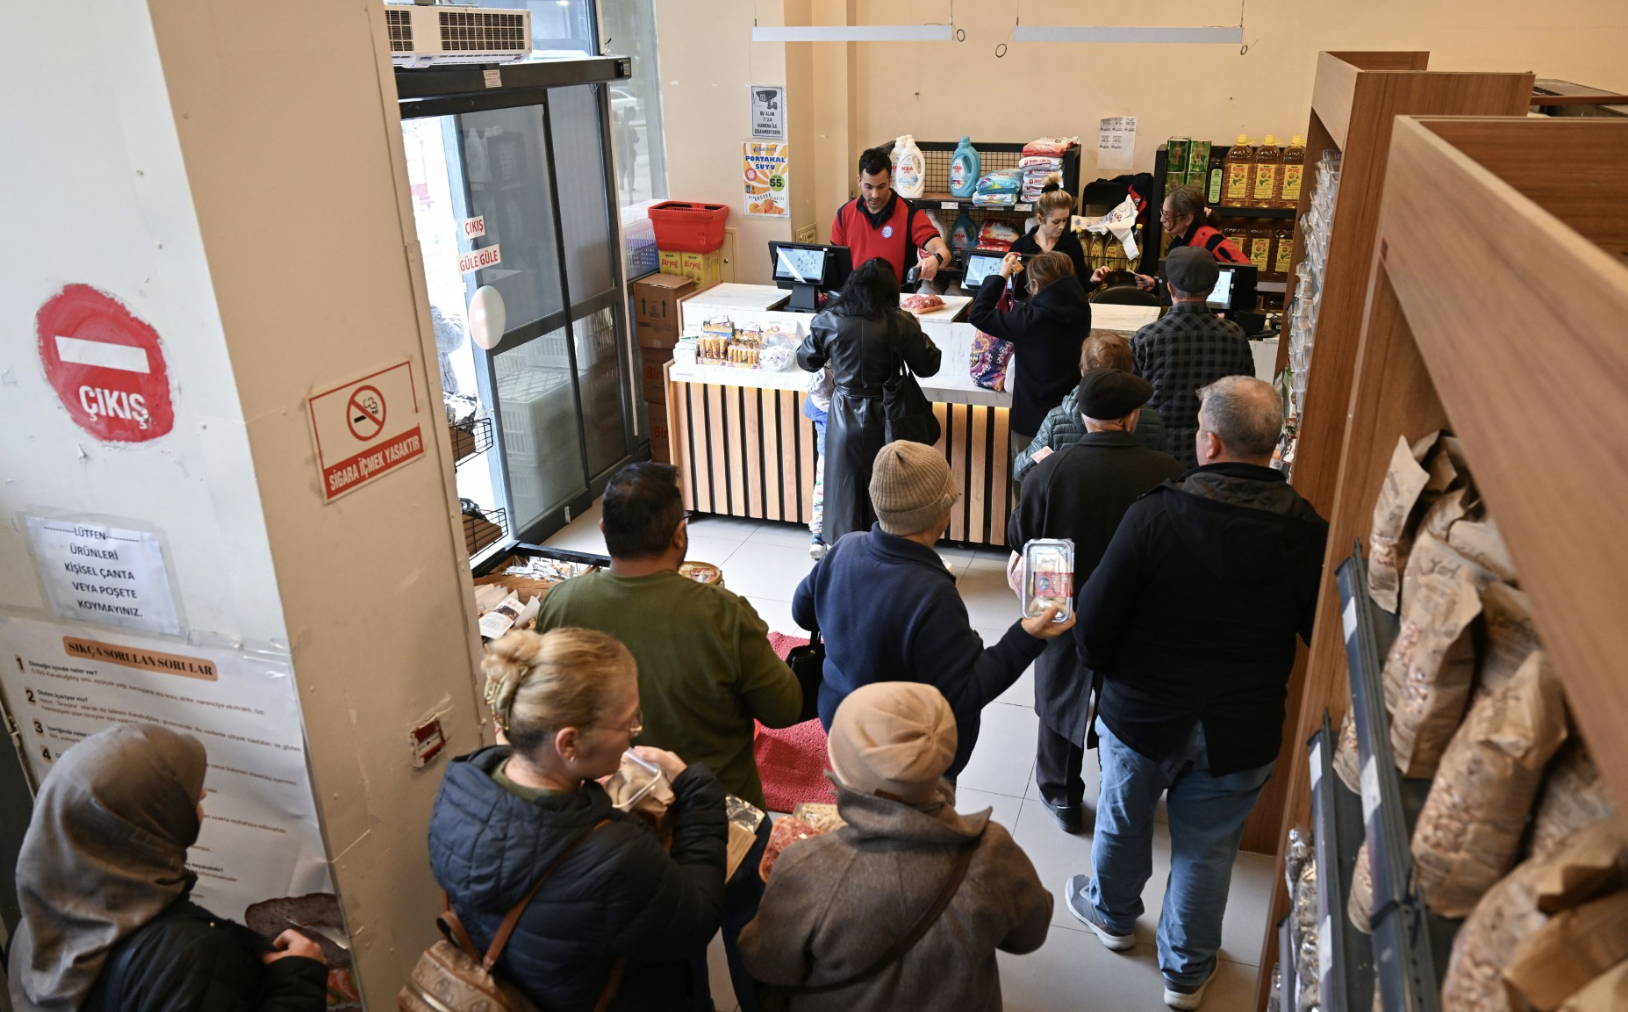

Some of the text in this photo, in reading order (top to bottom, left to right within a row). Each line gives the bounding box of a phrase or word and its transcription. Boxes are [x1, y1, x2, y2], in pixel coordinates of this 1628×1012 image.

[465, 219, 484, 236] ÇIKIŞ
[460, 250, 498, 272] GÜLE GÜLE
[78, 385, 149, 429] ÇIKIŞ
[329, 435, 420, 491] SİGARA İÇMEK YASAKTIR
[70, 543, 119, 560] ÜRÜNLERİ
[64, 562, 136, 580] KİŞİSEL ÇANTA
[72, 582, 138, 598] VEYA POŞETE
[77, 600, 143, 617] KOYMAYINIZ.
[16, 657, 24, 670] 1
[68, 642, 213, 675] SIKÇA SORULAN SORULAR
[25, 690, 36, 702] 2
[34, 721, 43, 734] 3
[43, 748, 51, 760] 4
